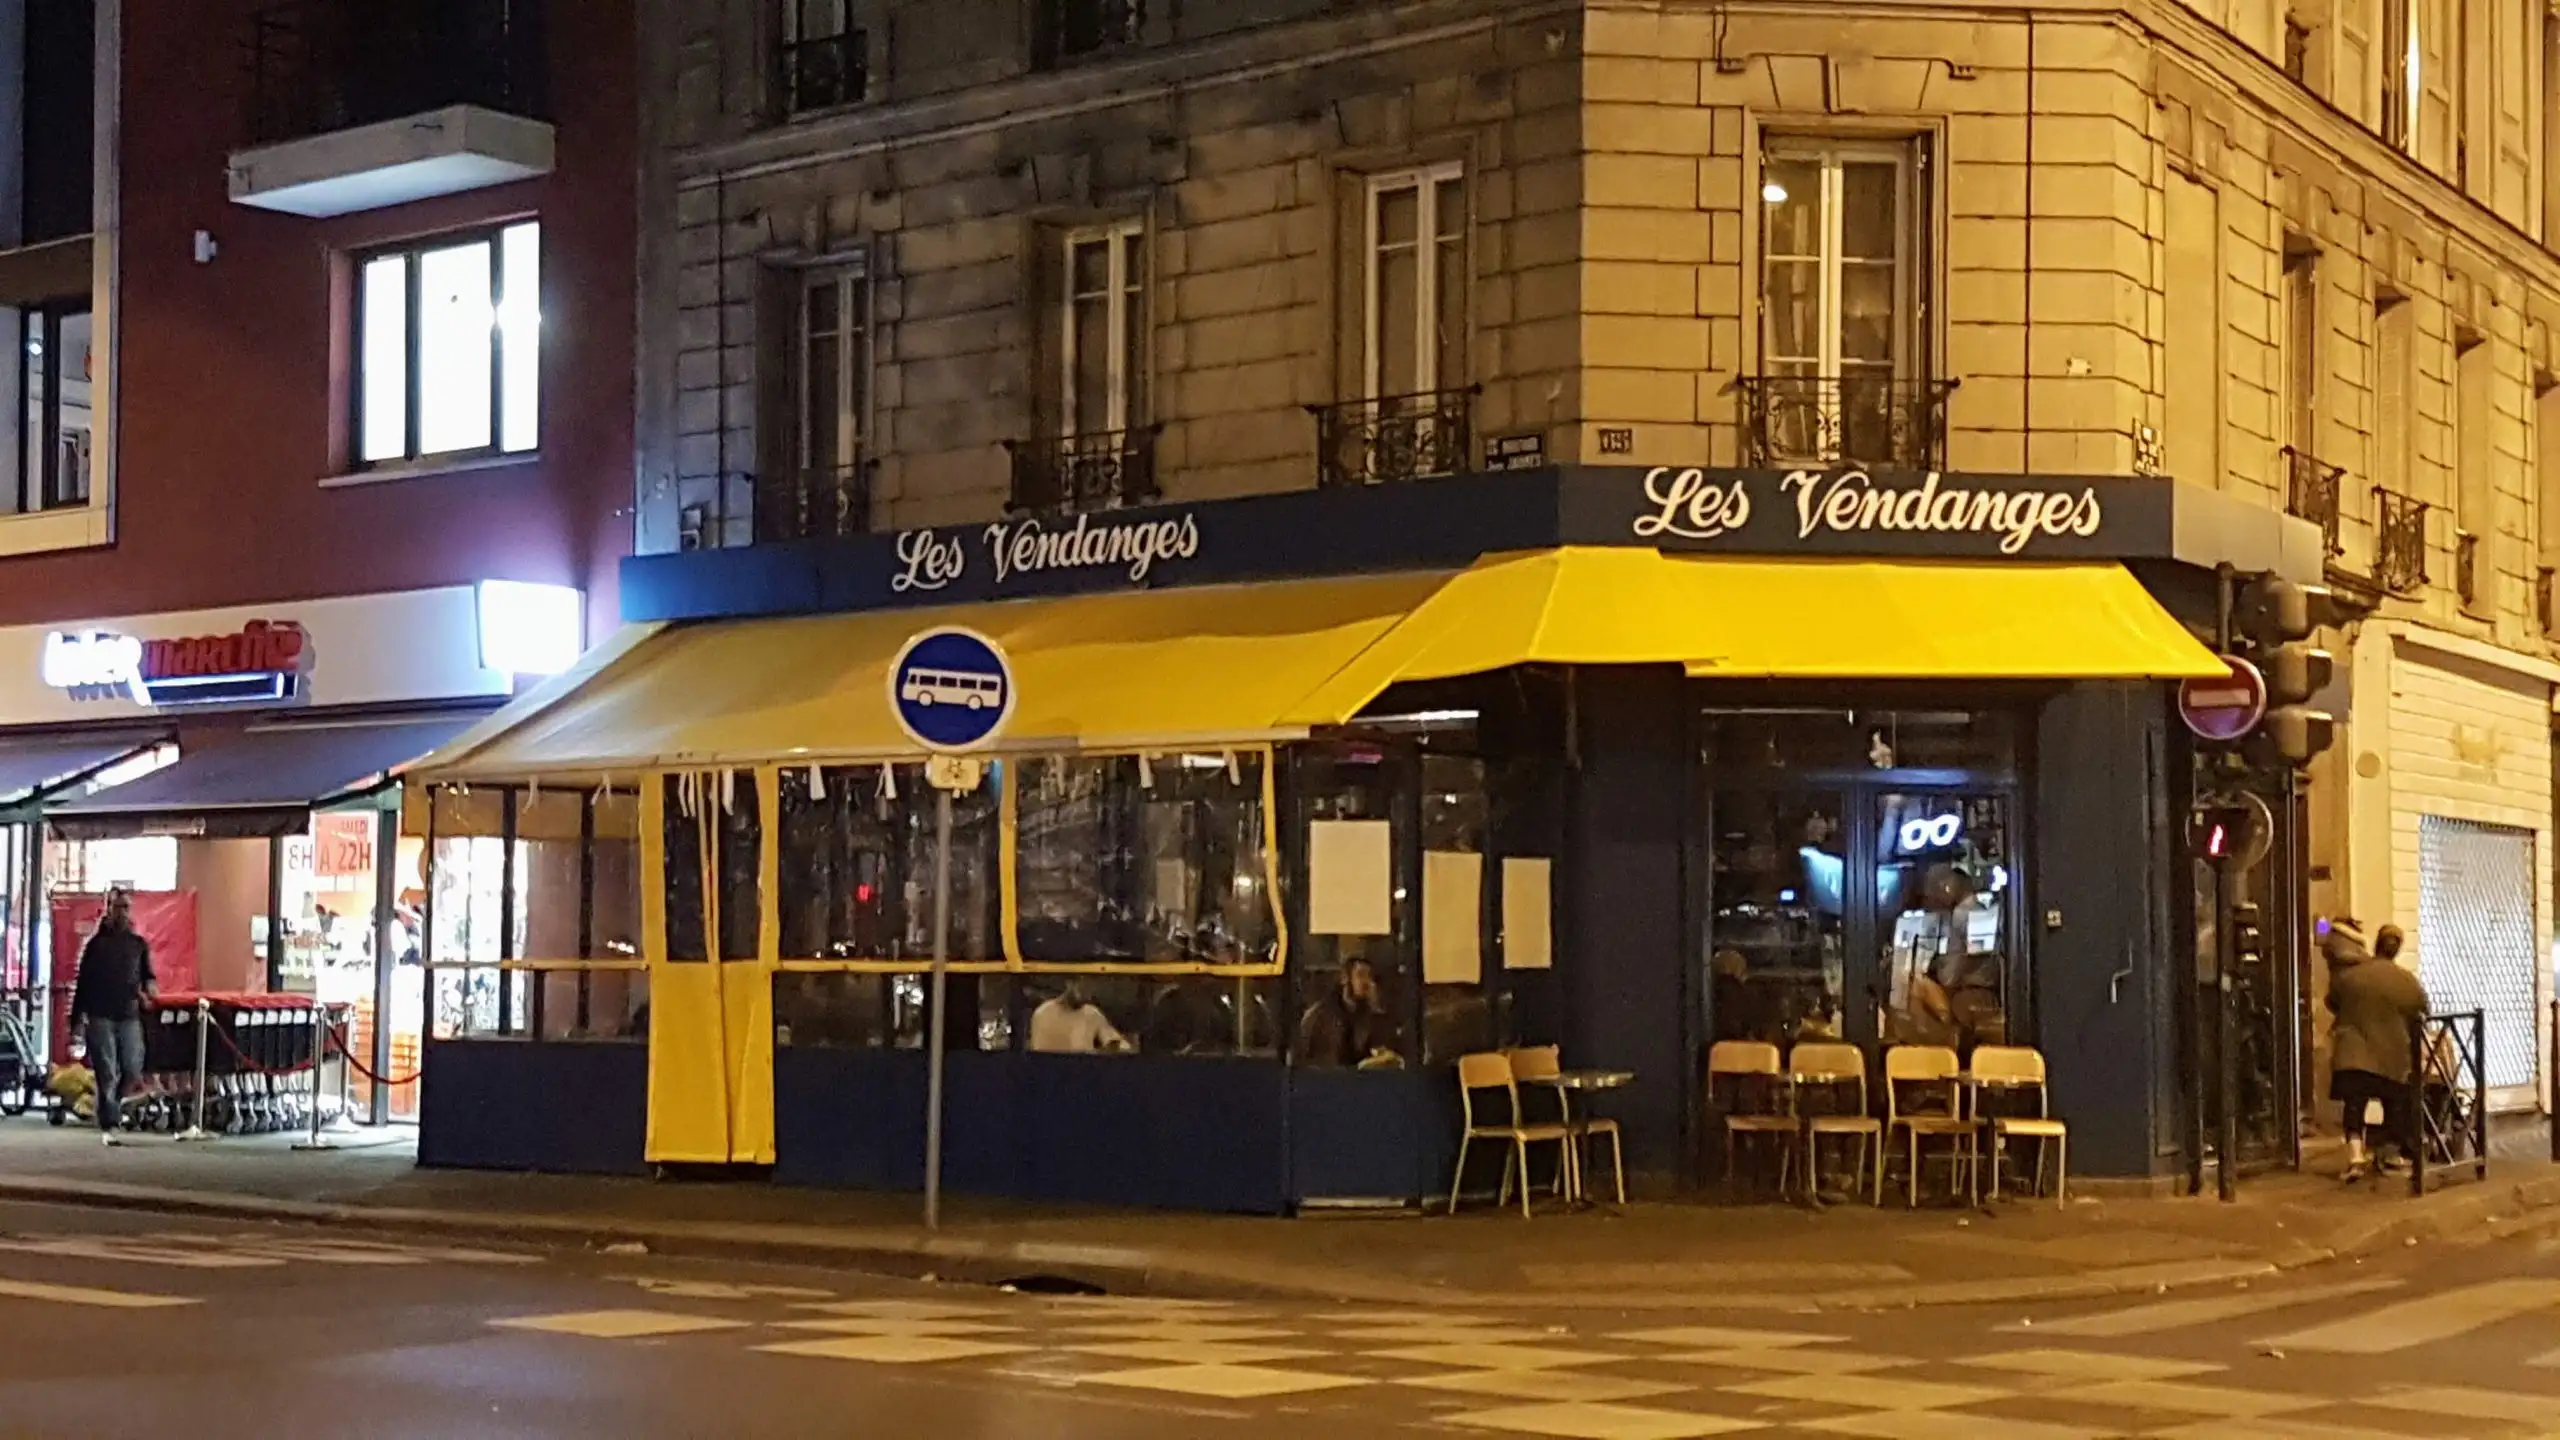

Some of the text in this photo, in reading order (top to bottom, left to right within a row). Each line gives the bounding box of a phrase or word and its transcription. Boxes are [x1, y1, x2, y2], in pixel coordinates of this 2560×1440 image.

[1632, 467, 2101, 554] Les Vendanges
[891, 513, 1199, 592] Les Vendanges
